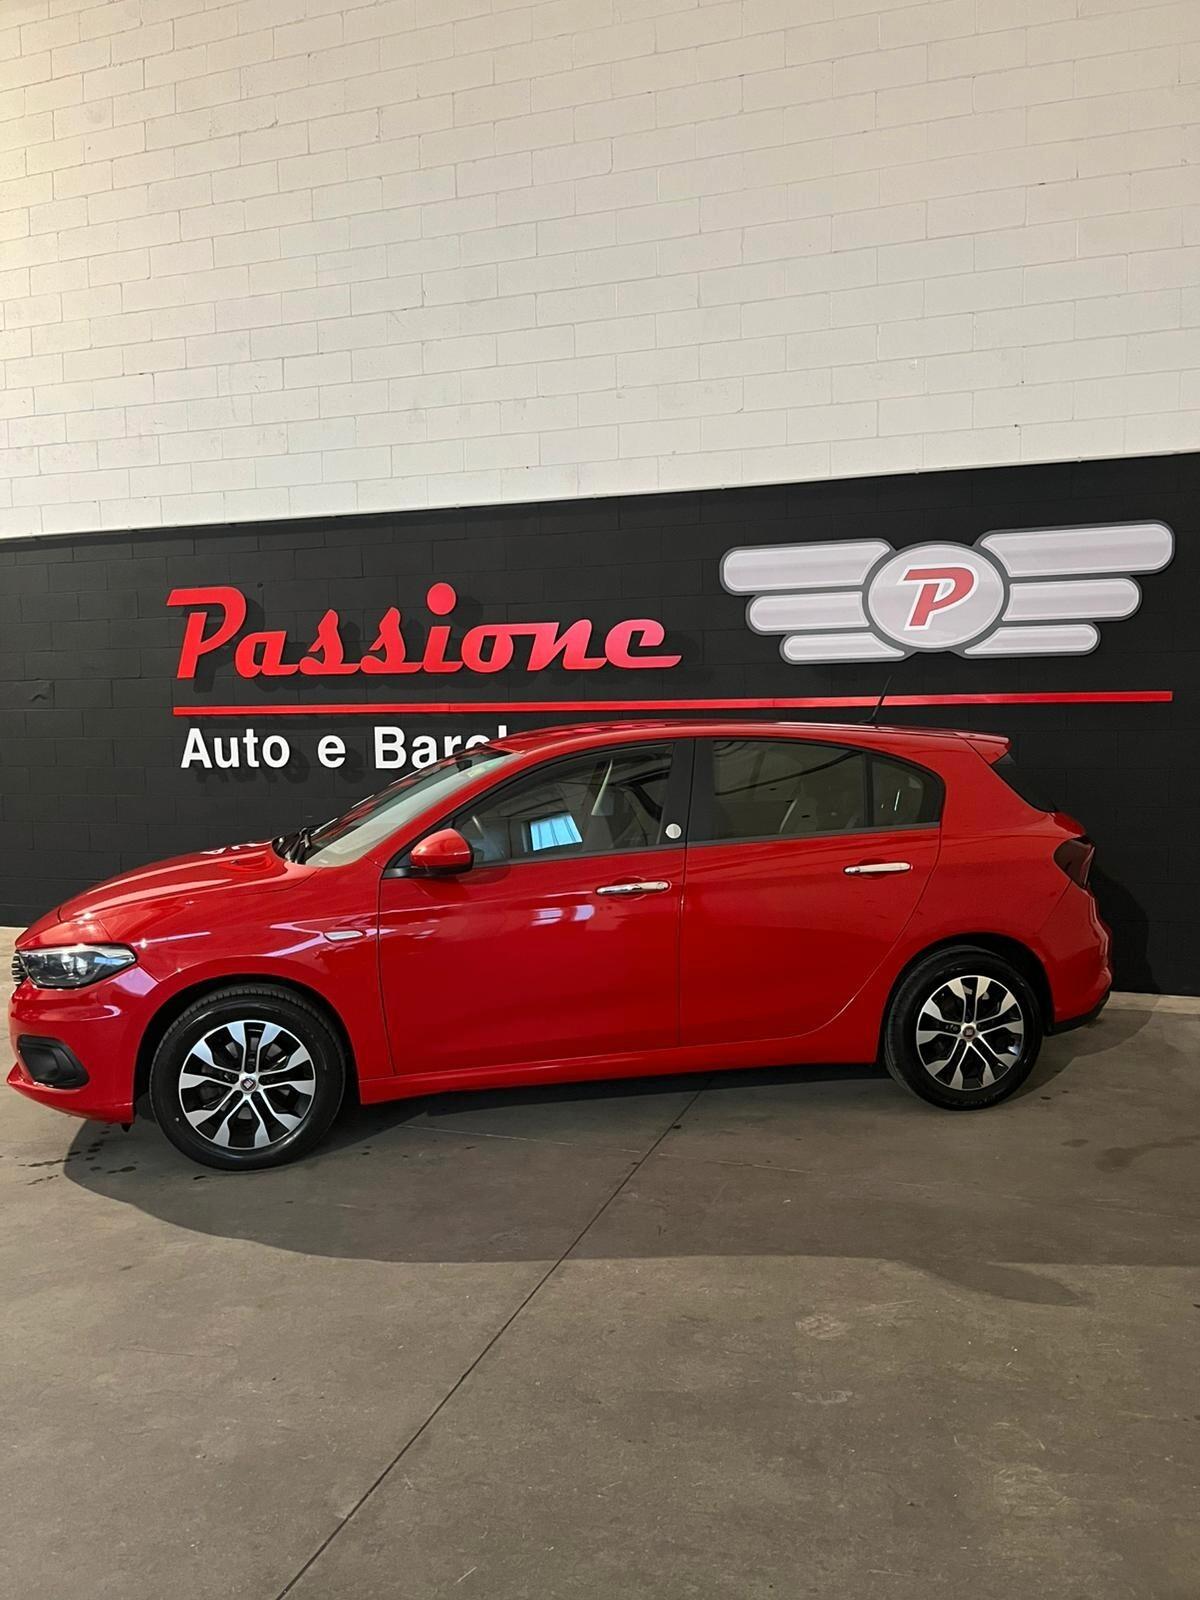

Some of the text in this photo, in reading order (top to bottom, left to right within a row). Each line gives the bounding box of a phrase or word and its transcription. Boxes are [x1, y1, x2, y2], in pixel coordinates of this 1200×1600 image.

[899, 564, 977, 629] P
[166, 582, 682, 680] Passione
[180, 725, 508, 769] Auto e Bar
